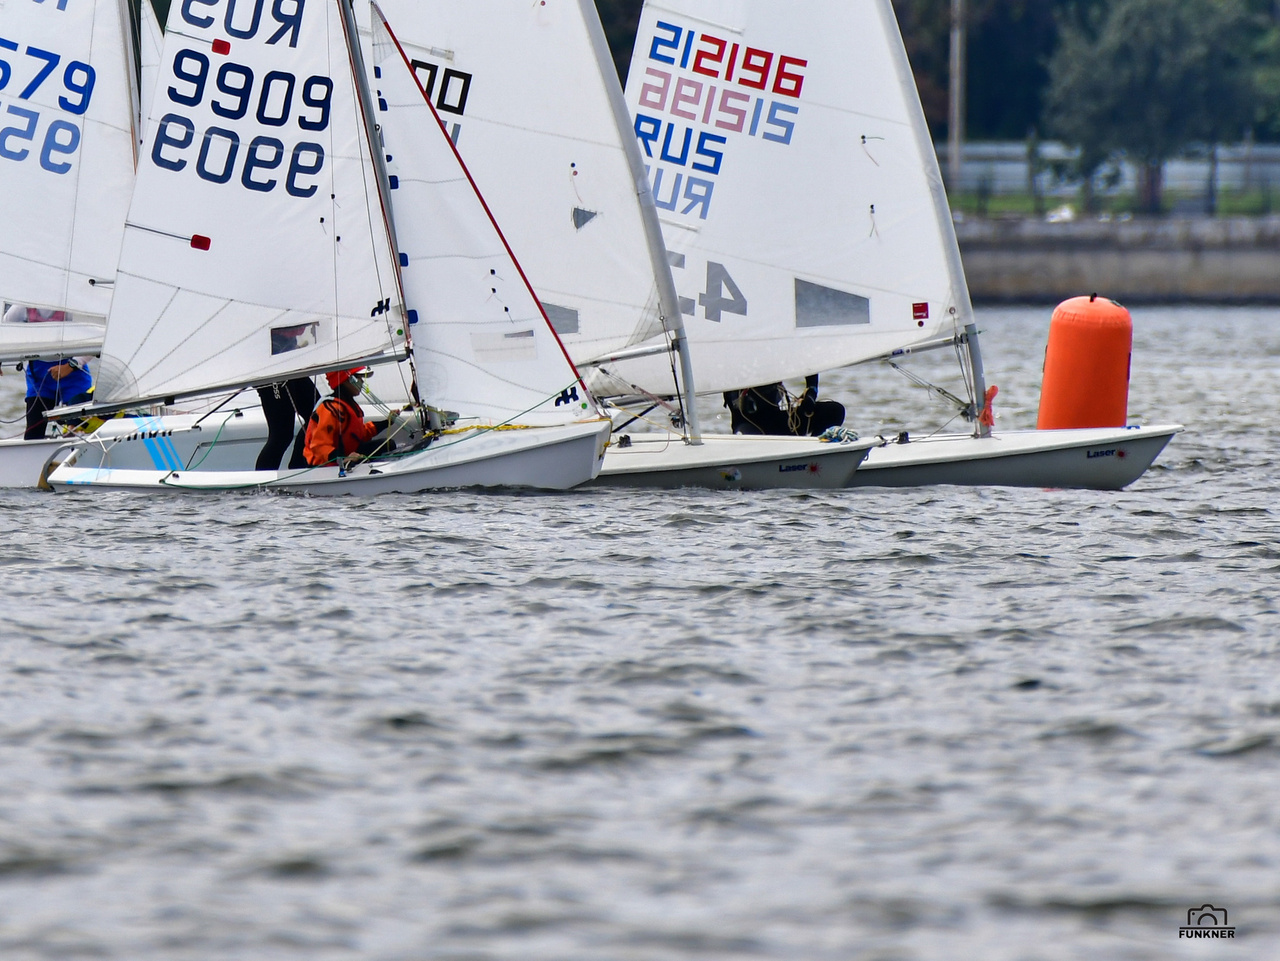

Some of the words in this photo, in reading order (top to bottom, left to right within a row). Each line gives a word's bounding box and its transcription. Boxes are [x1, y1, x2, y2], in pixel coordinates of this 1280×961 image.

[167, 49, 334, 131] 9909
[649, 20, 808, 99] 212196
[634, 113, 727, 175] RUS
[1086, 448, 1116, 459] Laser
